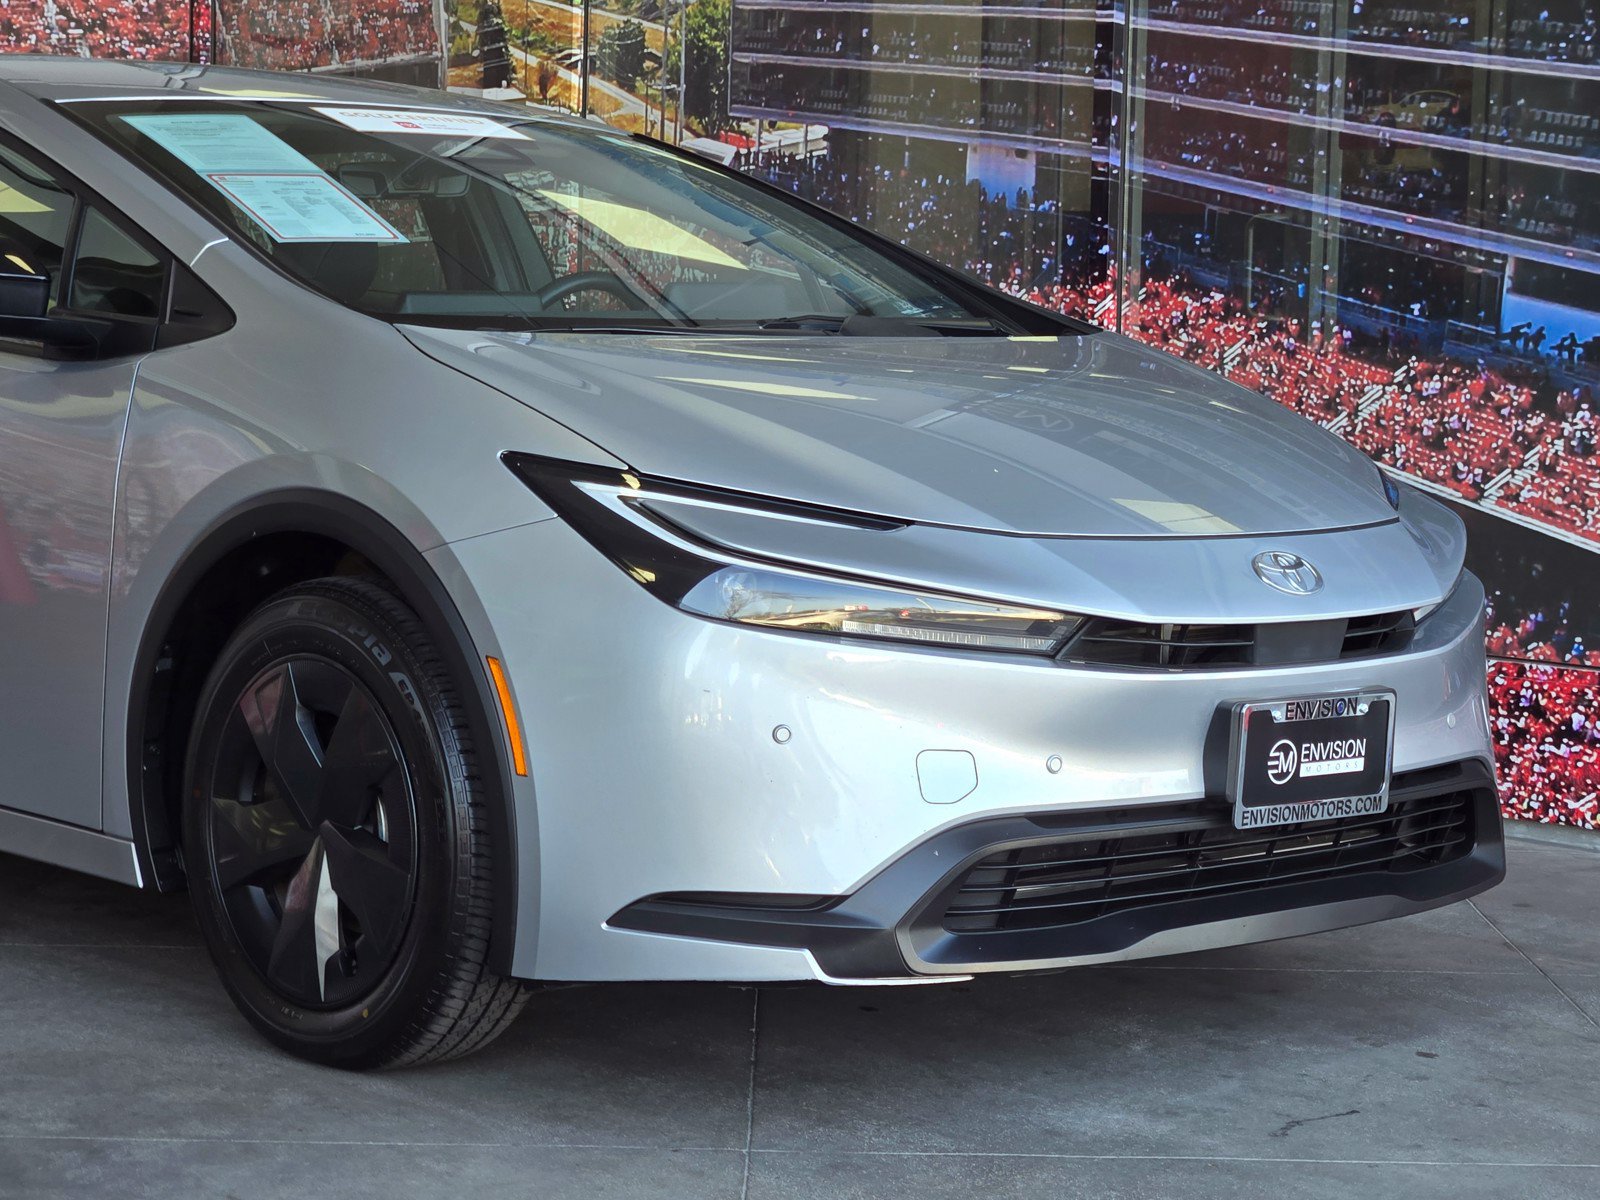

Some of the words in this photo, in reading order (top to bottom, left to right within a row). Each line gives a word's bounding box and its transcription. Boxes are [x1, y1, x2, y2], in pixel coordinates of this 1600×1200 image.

[1286, 697, 1358, 720] ENVISION
[1301, 738, 1366, 762] ENVISION
[1305, 762, 1359, 772] MOTORS
[1242, 796, 1382, 826] ENVISIONMOTORS.COM
